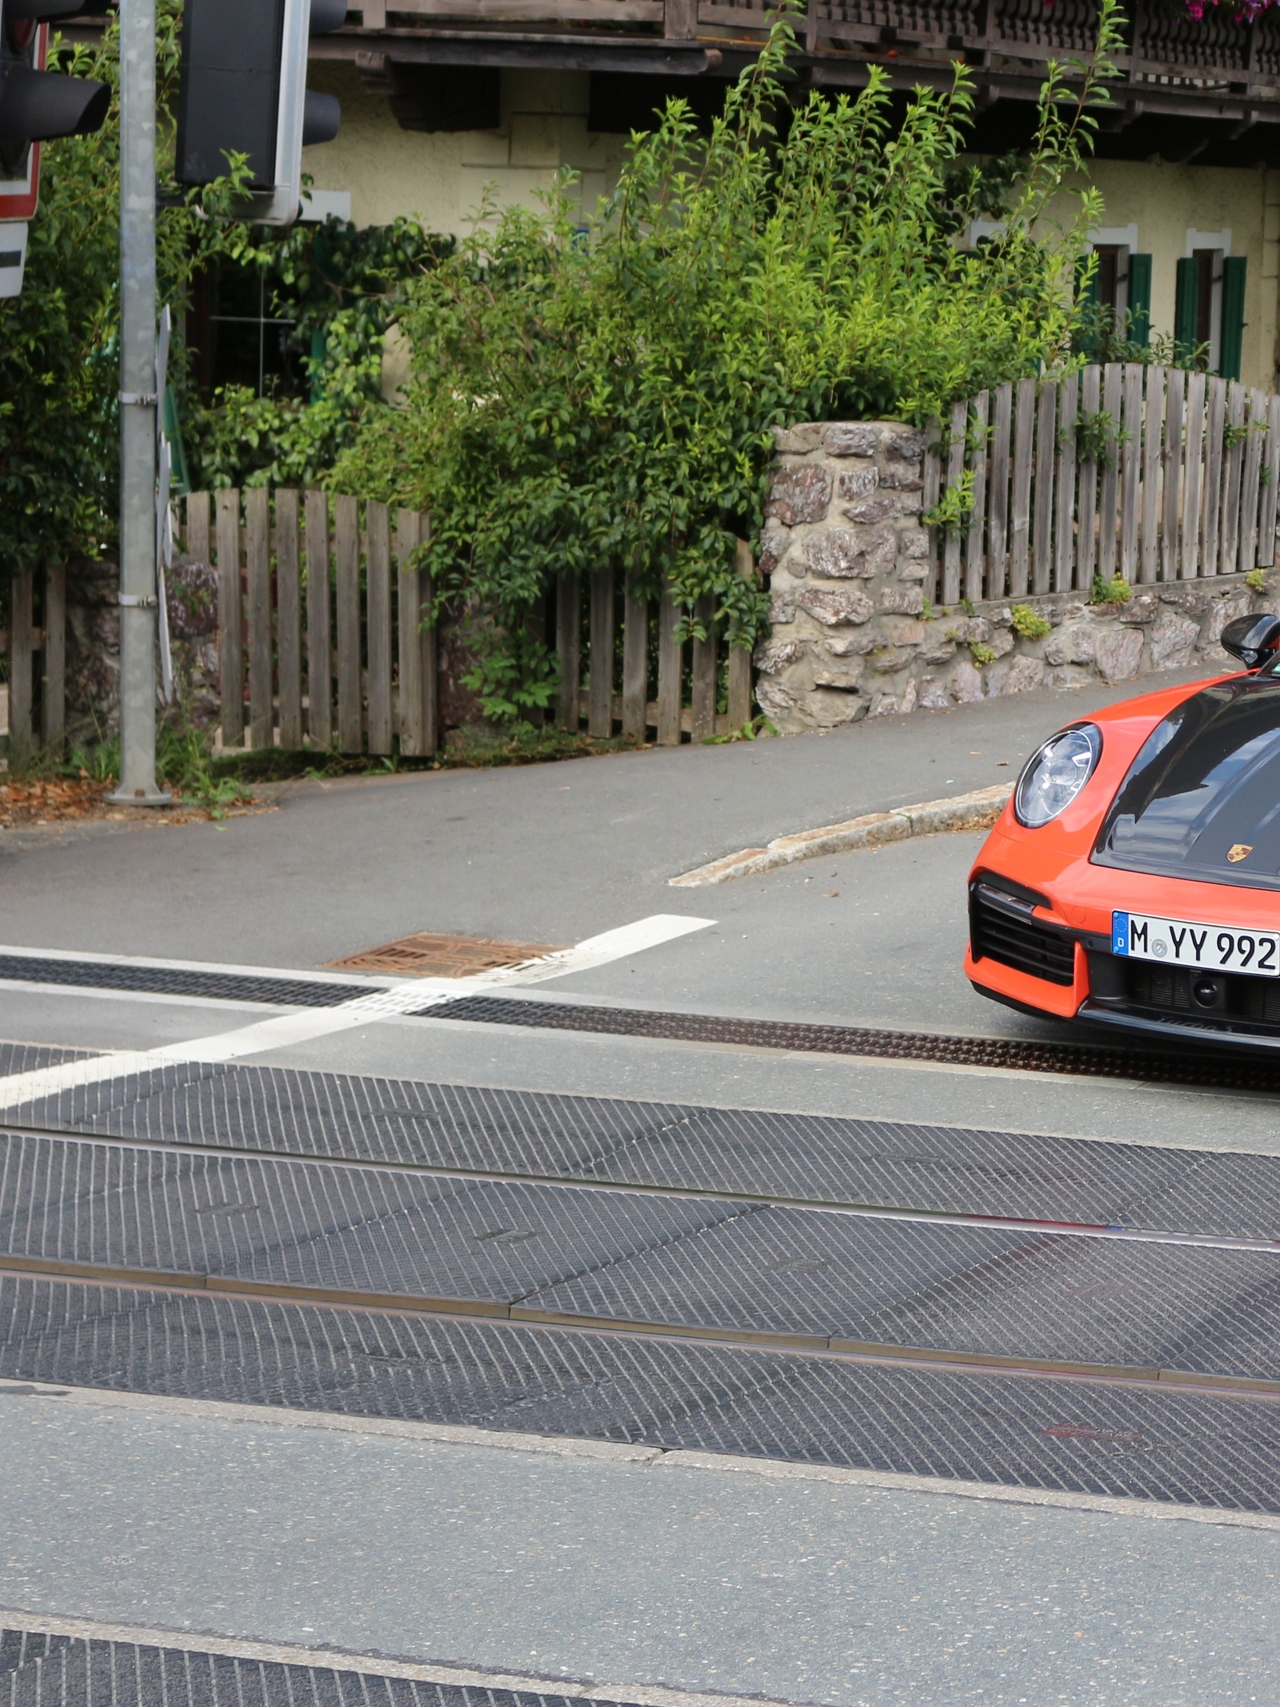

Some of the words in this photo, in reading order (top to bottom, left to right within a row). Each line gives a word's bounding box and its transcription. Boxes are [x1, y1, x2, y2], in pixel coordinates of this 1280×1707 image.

[1117, 937, 1125, 948] D
[1130, 919, 1148, 953] M
[1169, 925, 1208, 962] YY
[1216, 933, 1276, 970] 992
